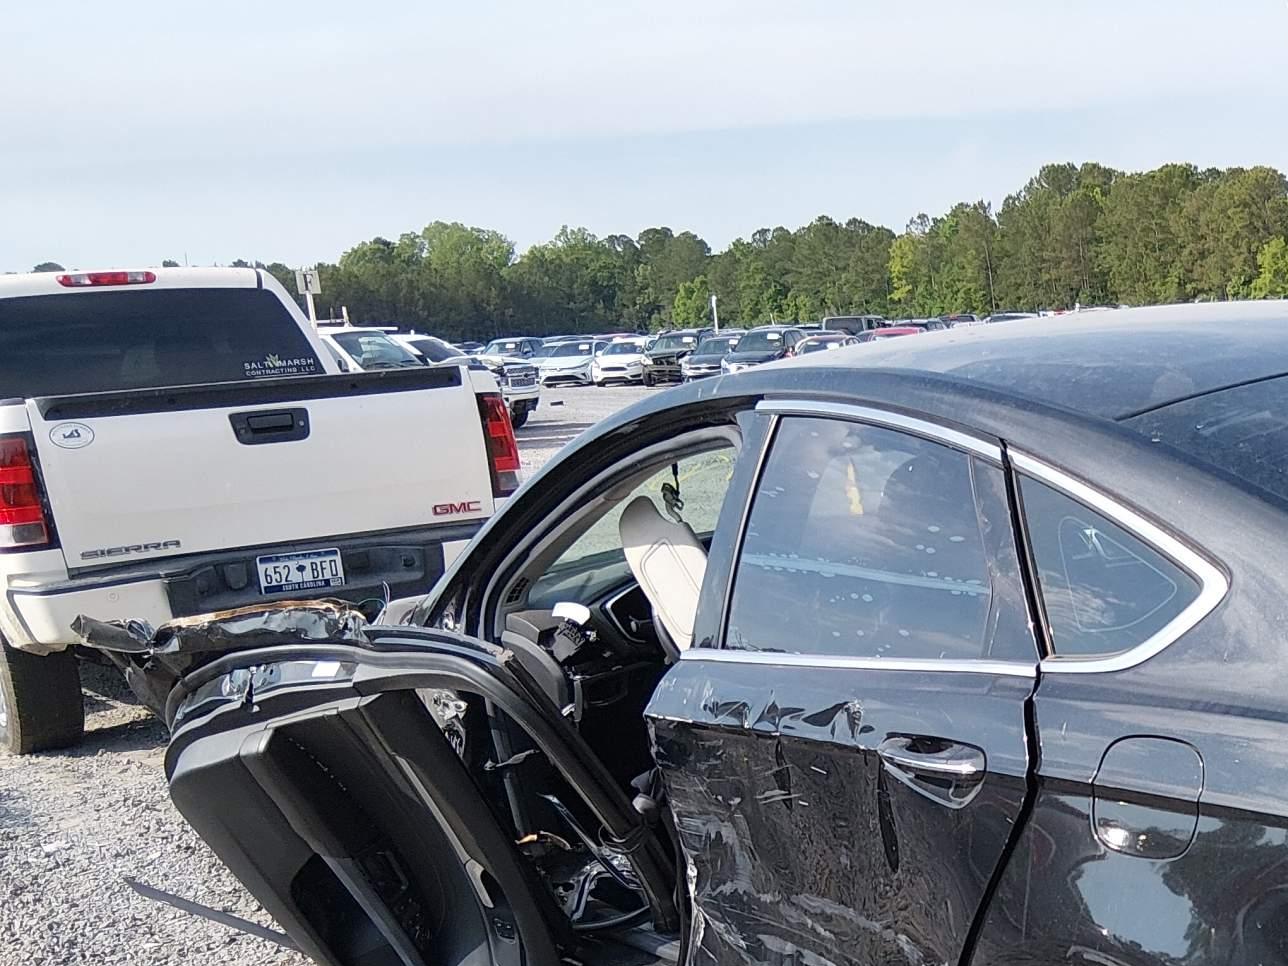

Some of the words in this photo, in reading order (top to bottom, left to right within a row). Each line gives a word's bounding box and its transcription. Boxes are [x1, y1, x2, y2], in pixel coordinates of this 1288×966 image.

[244, 361, 269, 370] SALT
[278, 358, 314, 367] MARSH
[246, 367, 298, 376] CONTRACTING
[432, 501, 481, 516] GMC
[80, 539, 181, 560] SIERRA
[264, 565, 293, 585] 652
